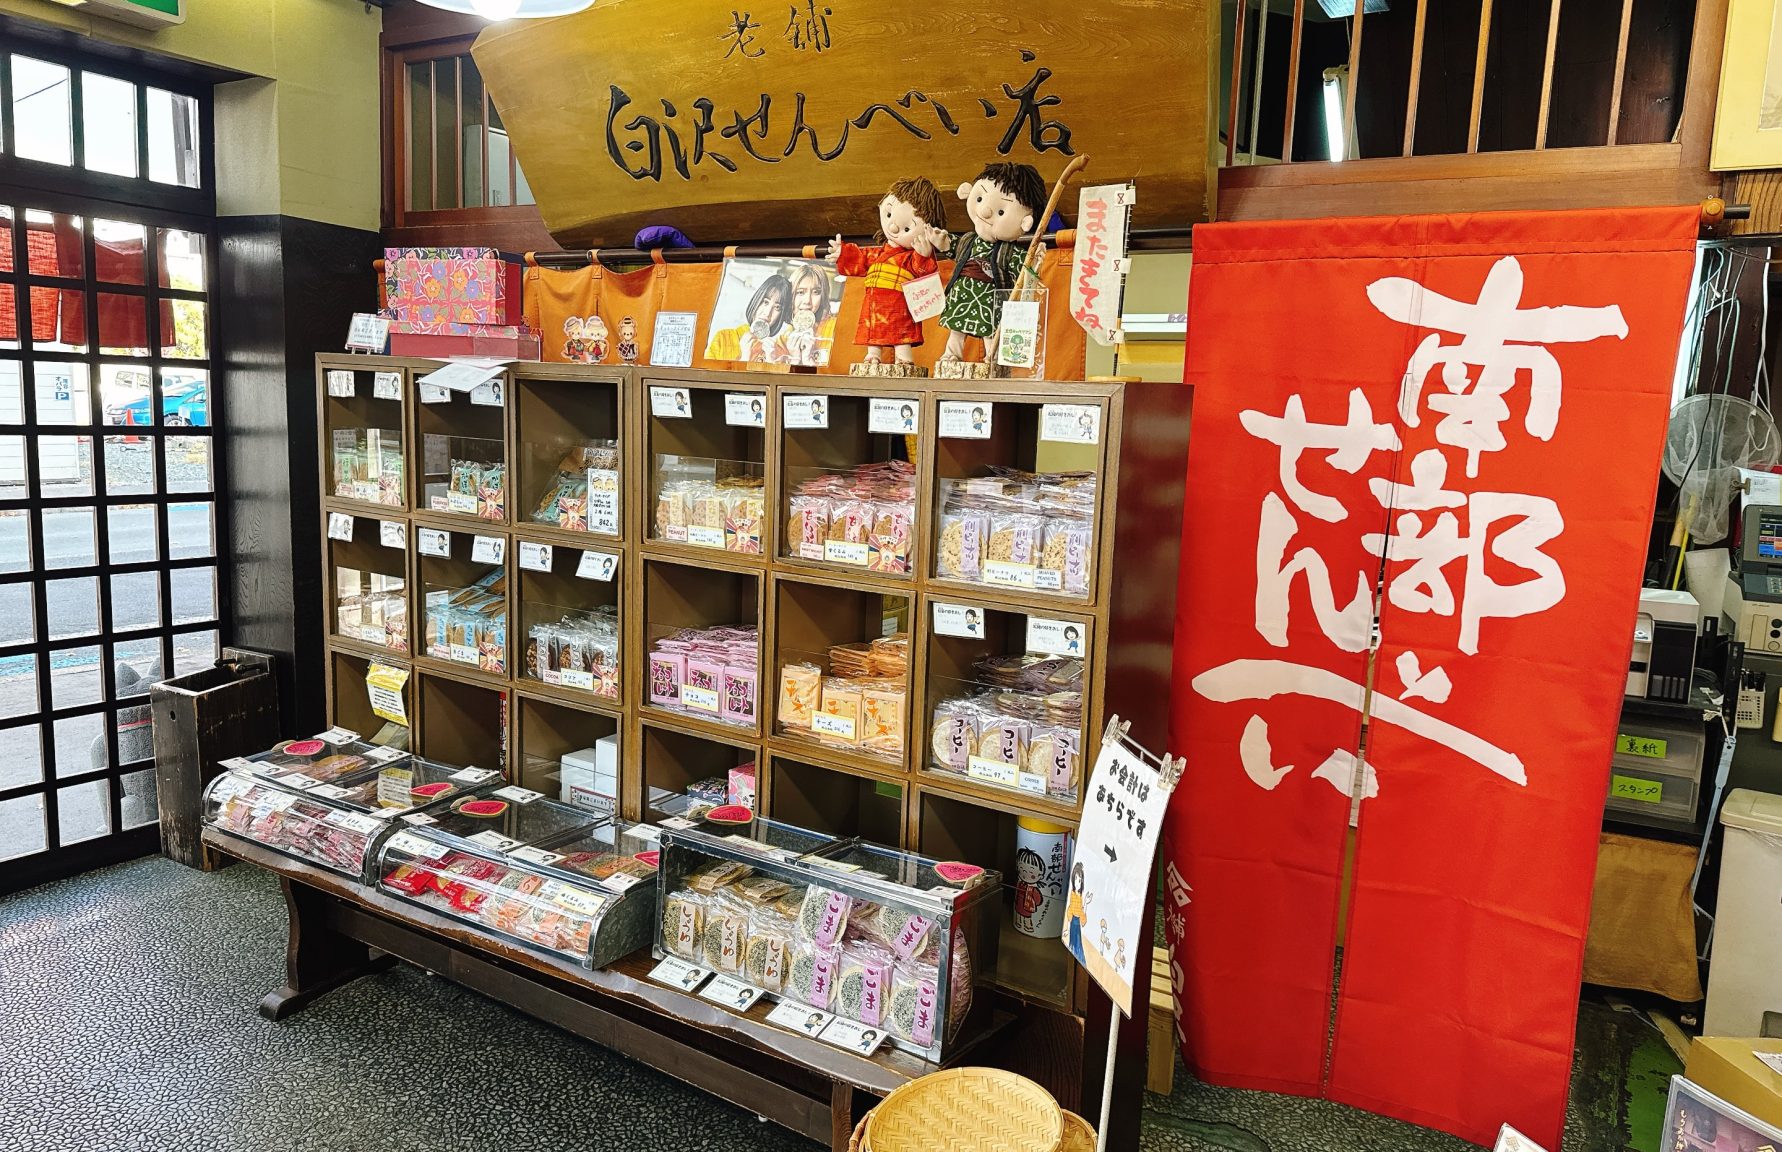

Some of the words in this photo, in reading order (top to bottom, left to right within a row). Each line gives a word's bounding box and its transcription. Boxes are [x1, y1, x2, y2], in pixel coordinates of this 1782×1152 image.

[722, 4, 832, 59] 老舗
[606, 49, 1076, 183] 白沢せんべい店
[1075, 198, 1109, 331] またきてね
[1362, 255, 1630, 657] 南部
[1191, 387, 1529, 800] せんべい
[952, 718, 964, 754] コーヒー
[1626, 738, 1658, 755] 裏紙
[1109, 758, 1150, 803] お会計は
[1618, 784, 1658, 796] スタンプ
[1096, 784, 1146, 840] あちらです
[1046, 842, 1063, 897] 南部せんべい
